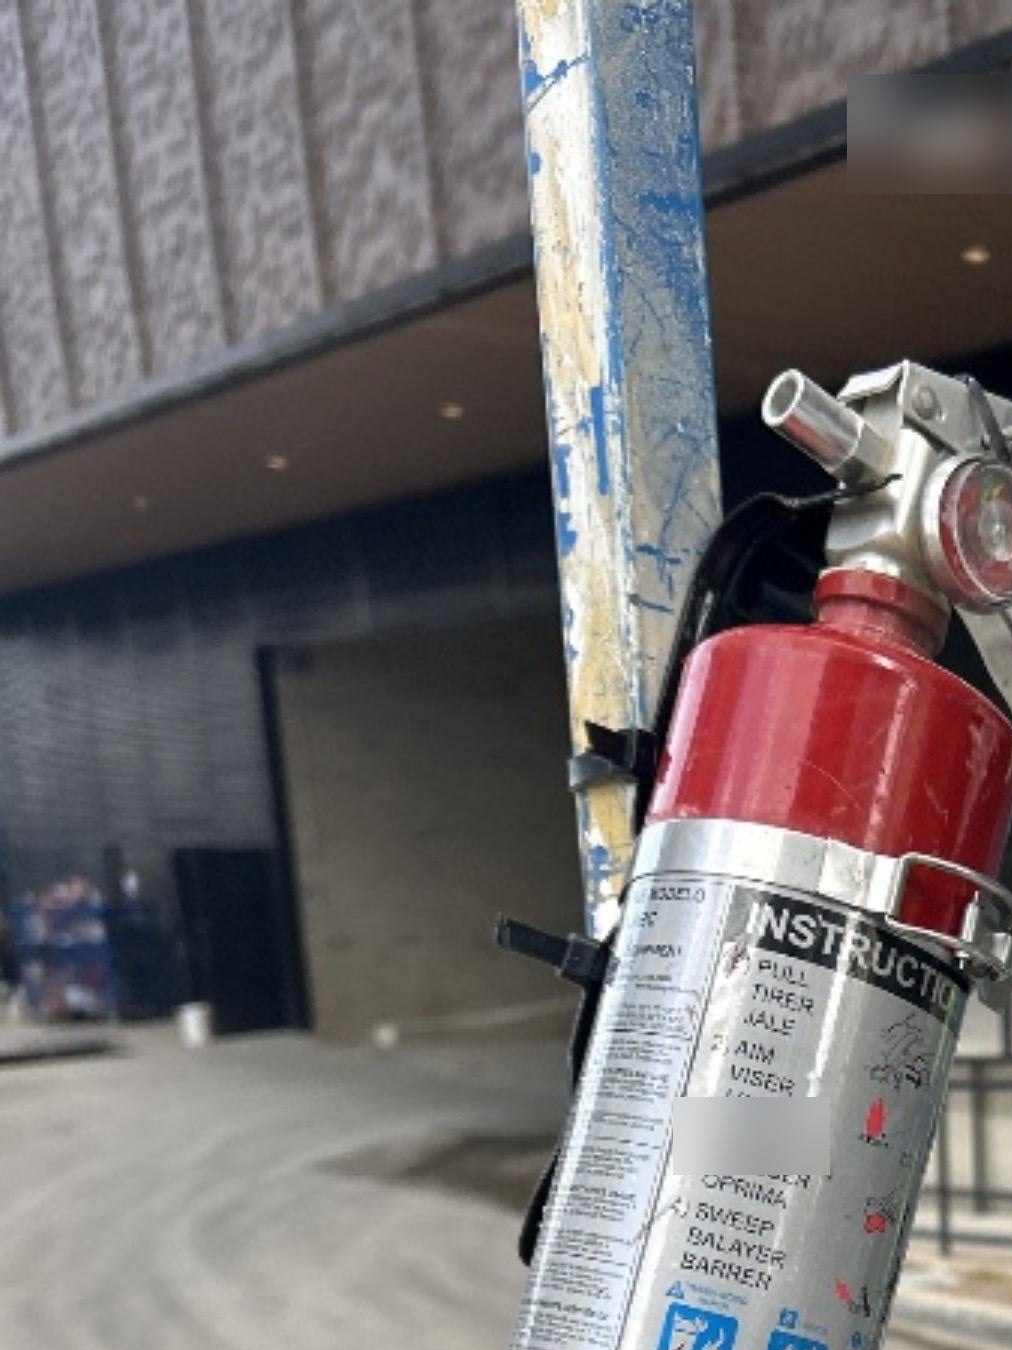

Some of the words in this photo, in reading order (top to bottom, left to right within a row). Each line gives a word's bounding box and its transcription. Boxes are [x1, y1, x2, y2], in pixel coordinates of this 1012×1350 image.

[758, 959, 808, 988] PULL
[752, 983, 815, 1017] TIRER
[743, 1010, 796, 1036] JALE
[735, 1040, 775, 1065] AIM
[731, 1064, 796, 1097] VISER
[695, 1201, 775, 1237] SWEEP
[686, 1226, 787, 1270] BALAYER
[680, 1252, 772, 1290] BARRER
